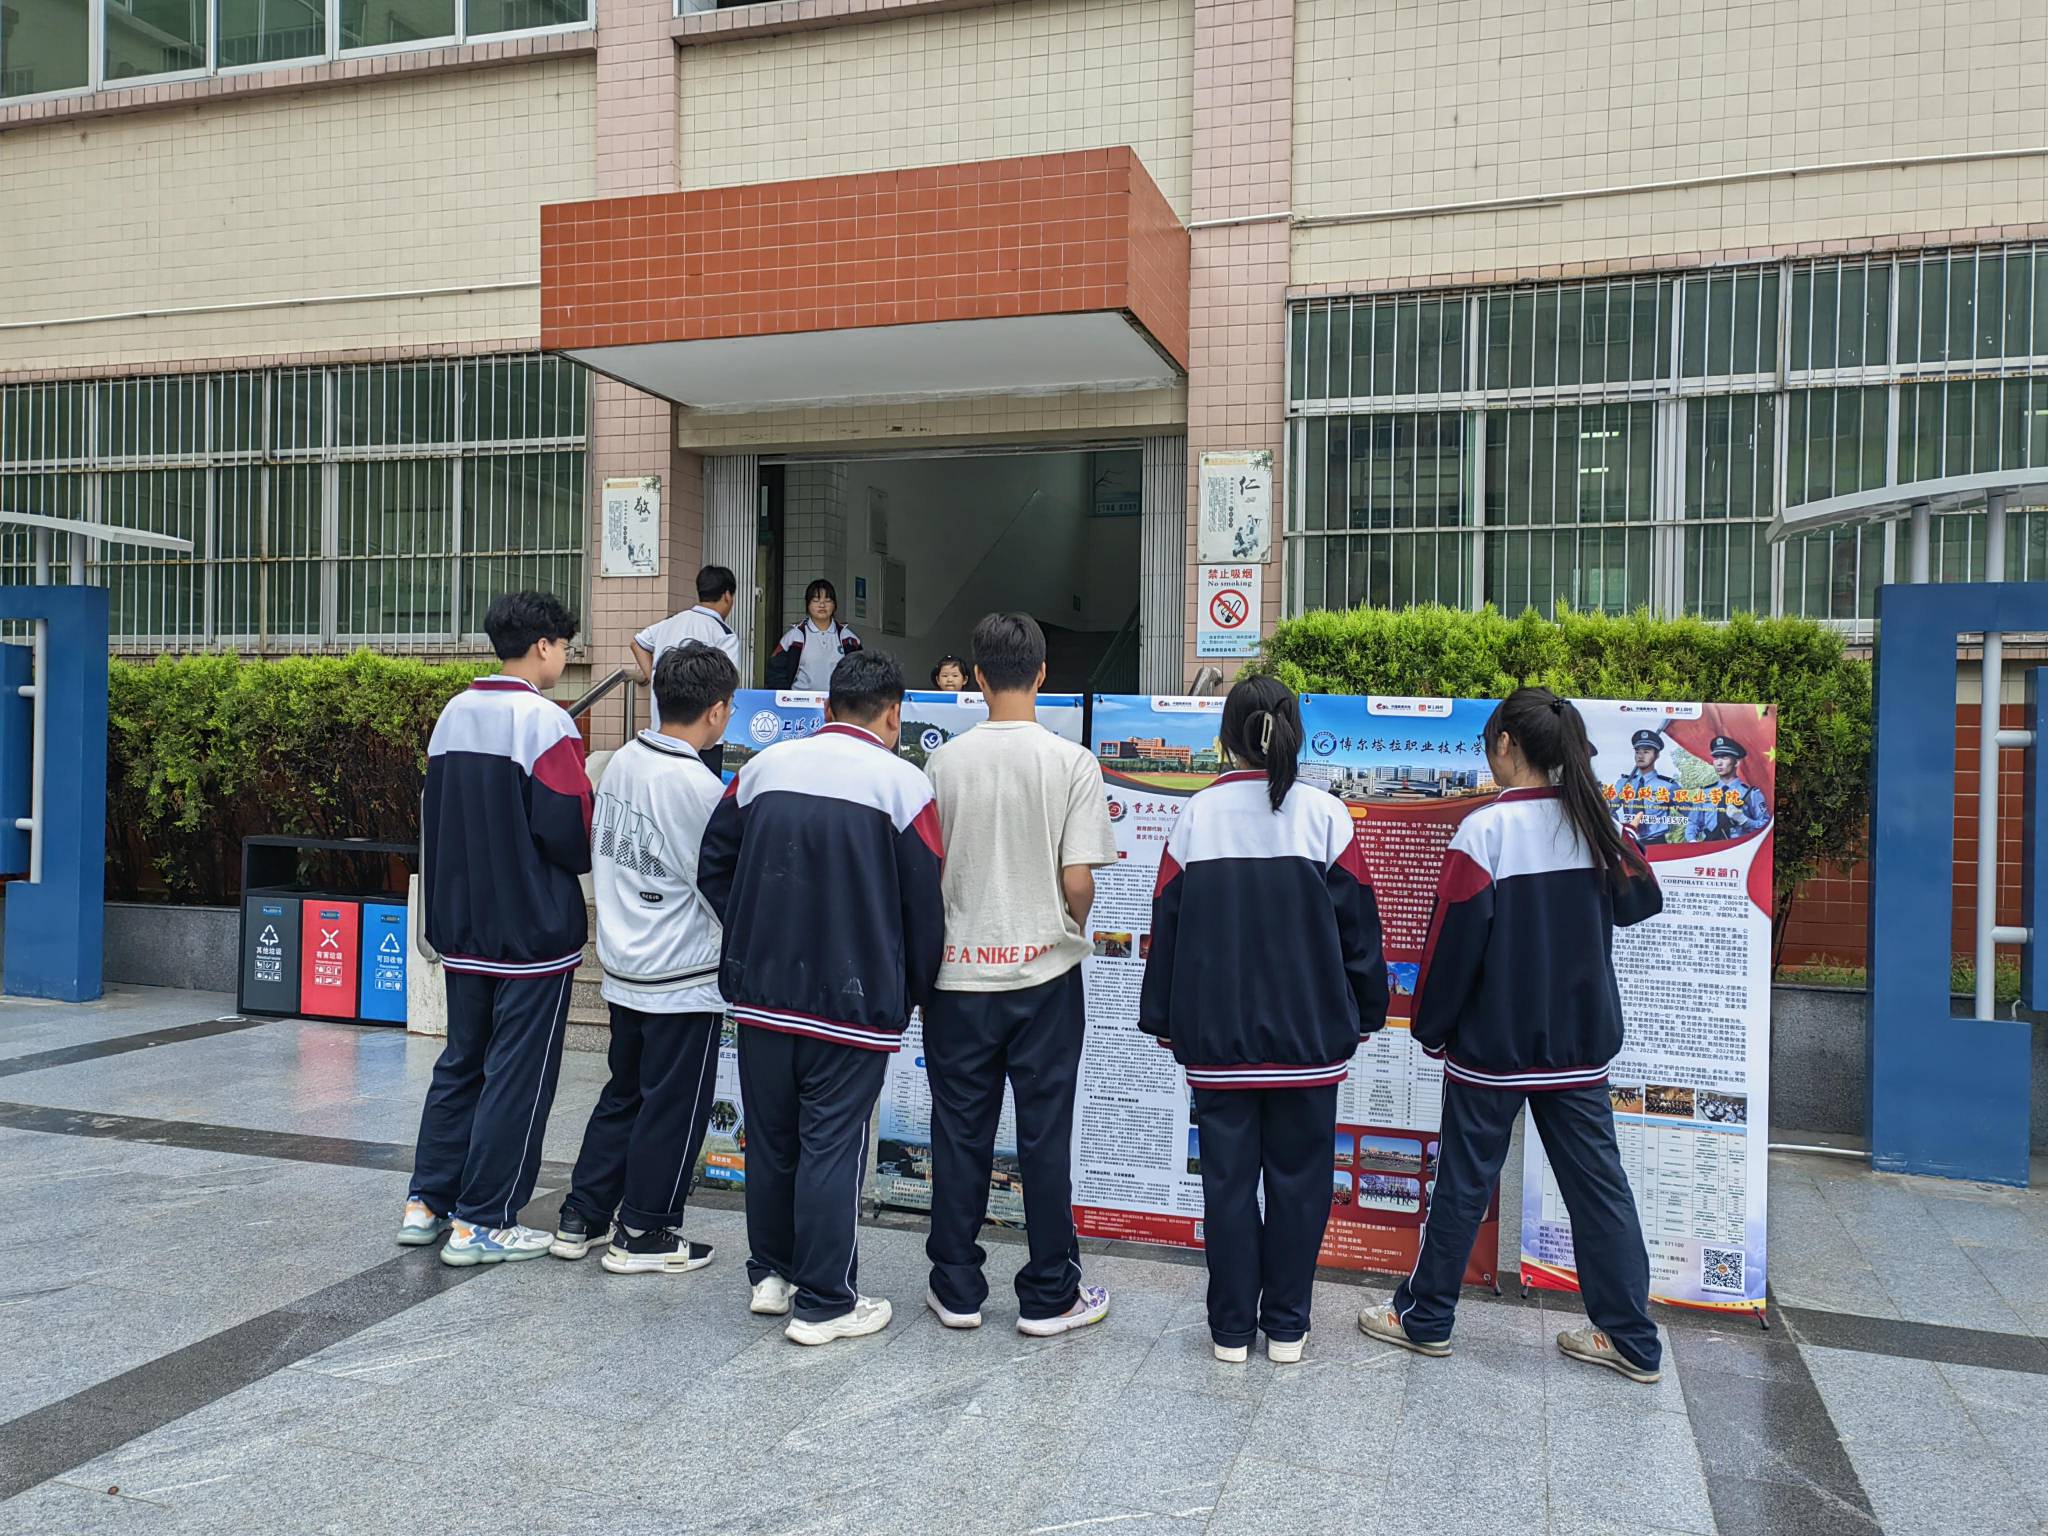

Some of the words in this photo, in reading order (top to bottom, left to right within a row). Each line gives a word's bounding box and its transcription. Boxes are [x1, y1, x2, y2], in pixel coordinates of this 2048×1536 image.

[1208, 569, 1253, 579] 禁止吸烟
[1221, 580, 1252, 588] smoking
[1340, 736, 1484, 756] 博尔塔拉职业技术学
[1602, 783, 1744, 805] 海南政法职业学院
[1132, 802, 1180, 815] 重庆文化
[1663, 878, 1705, 887] CORPORATE
[256, 946, 282, 955] 其他垃圾
[316, 951, 342, 960] 有害垃圾
[959, 946, 971, 964] A
[977, 946, 1019, 964] NIKE
[377, 955, 403, 964] 可回收物
[1592, 1333, 1609, 1350] N
